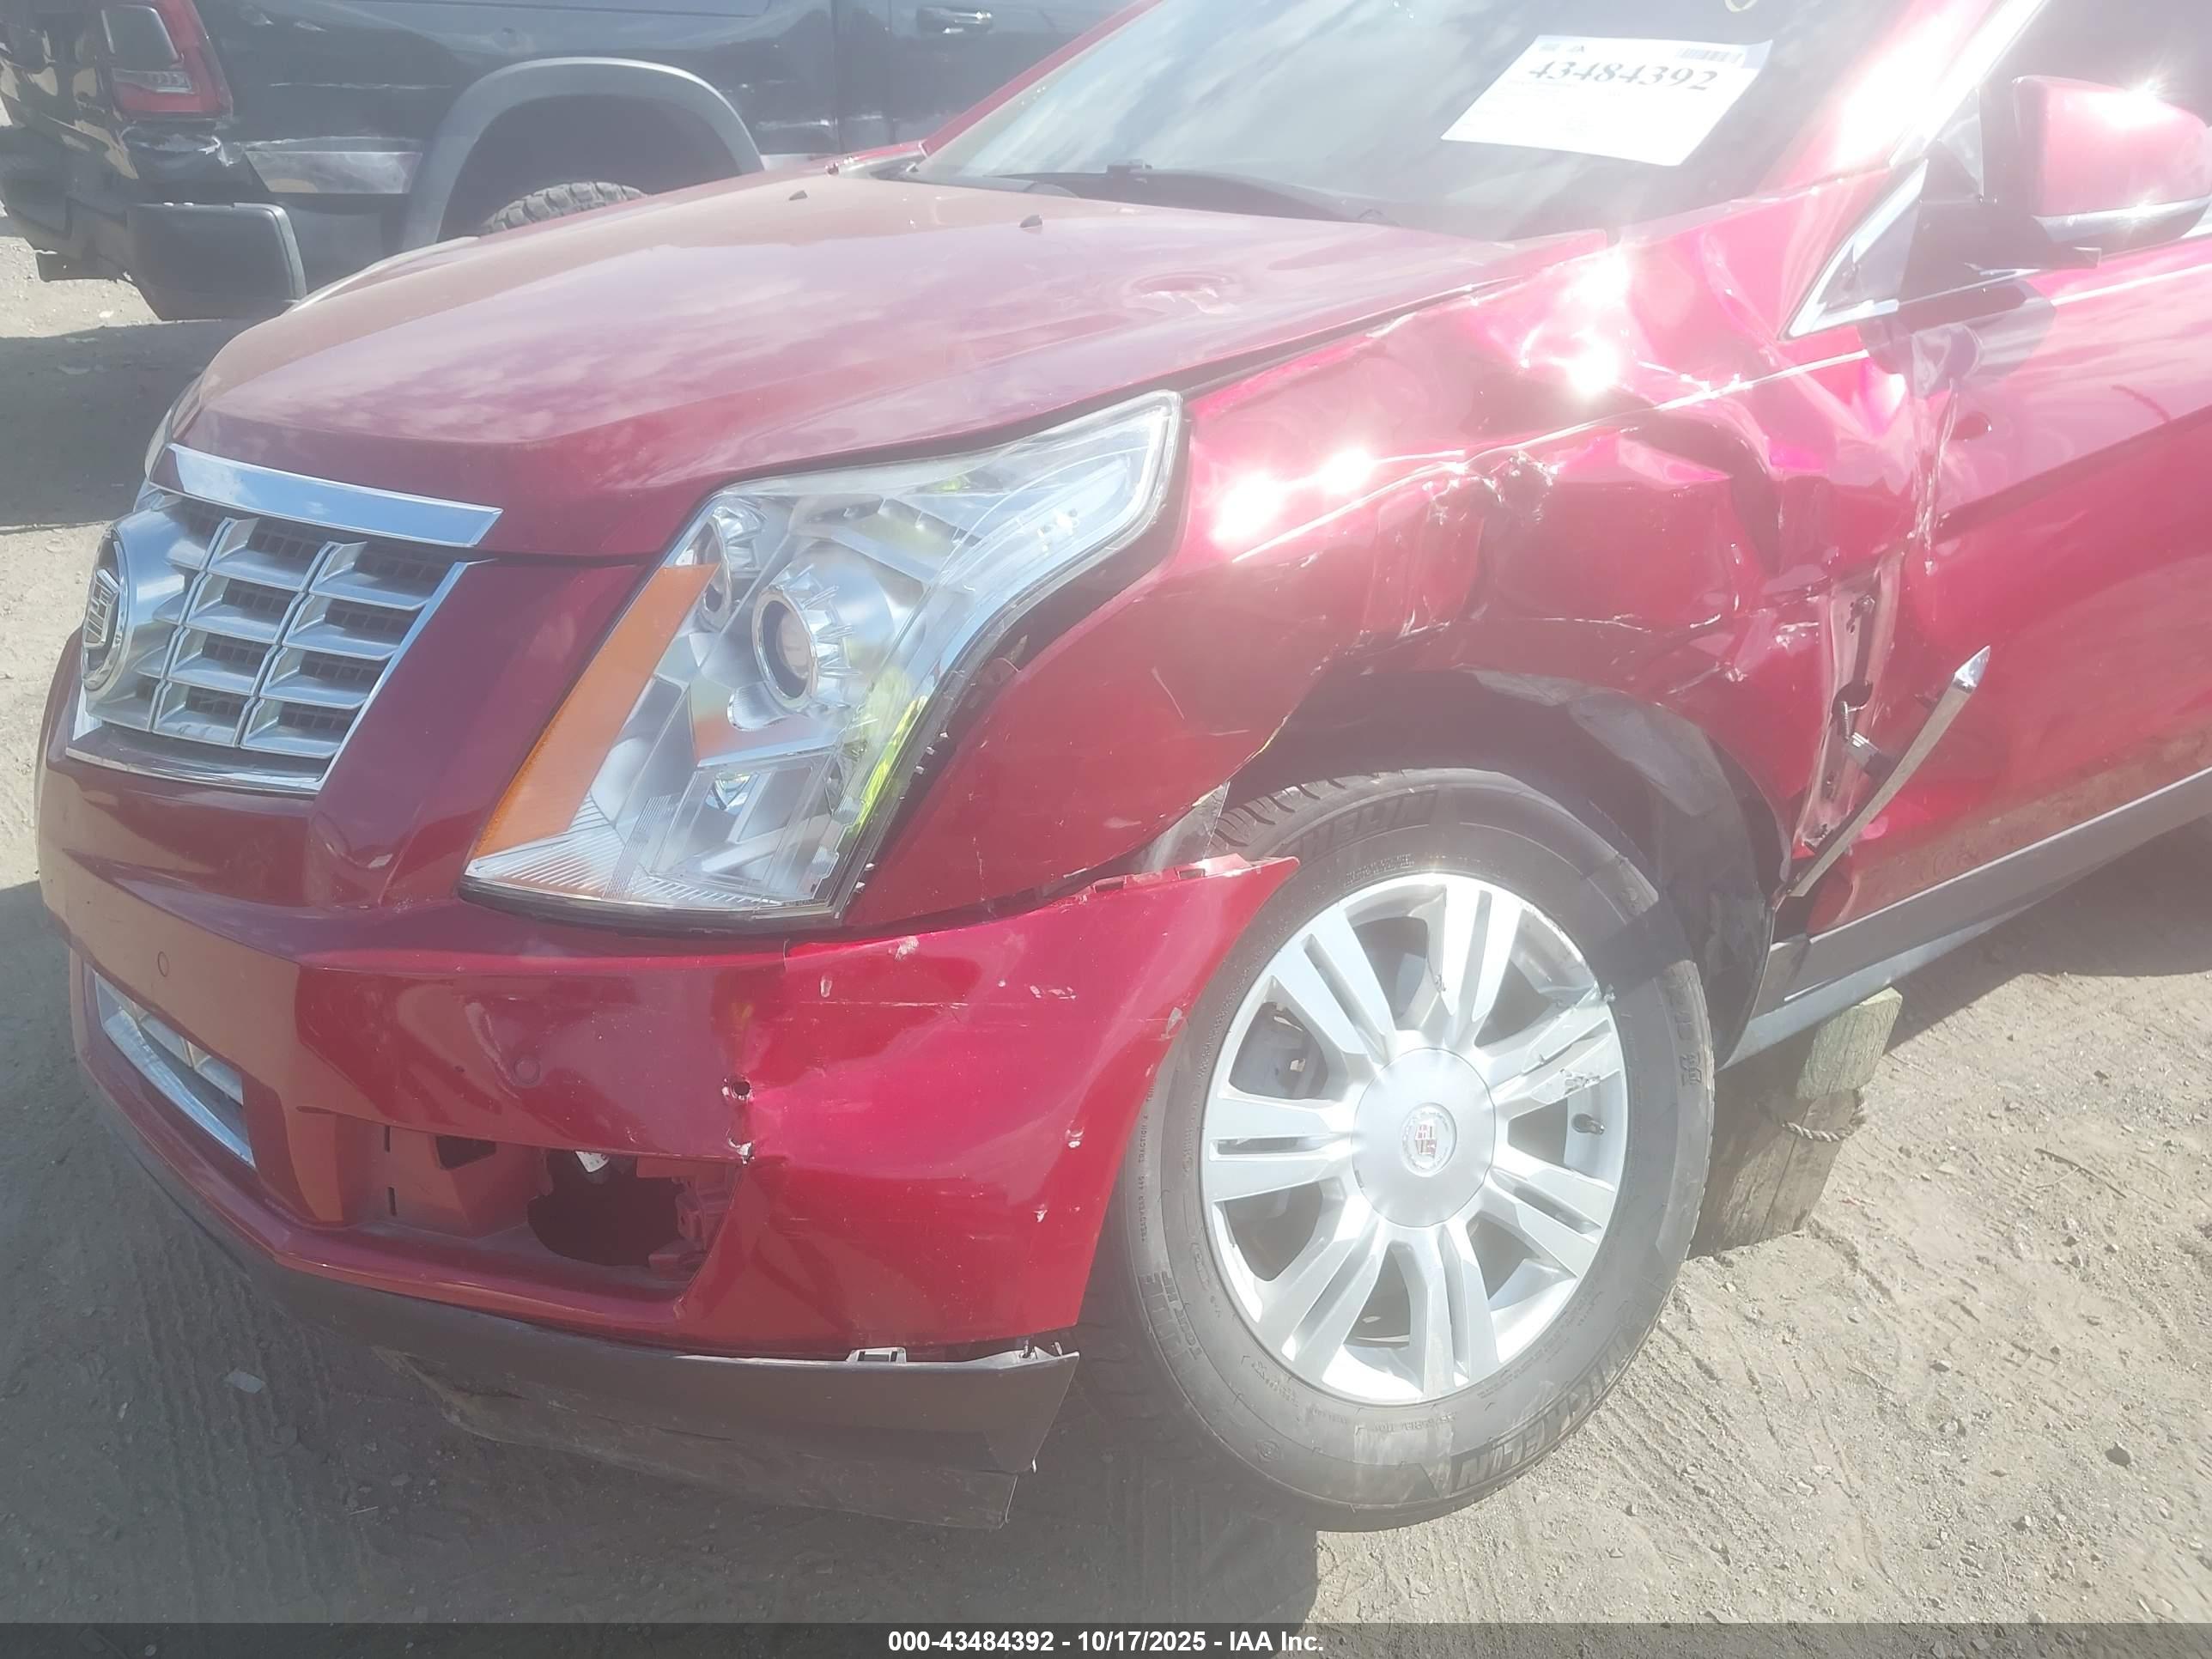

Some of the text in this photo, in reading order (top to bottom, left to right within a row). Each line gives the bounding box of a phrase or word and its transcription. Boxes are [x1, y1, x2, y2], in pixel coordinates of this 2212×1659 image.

[1528, 59, 1718, 91] 43484392
[1138, 1124, 1148, 1164] TRACTION
[1451, 1338, 1630, 1492] MICHELIN
